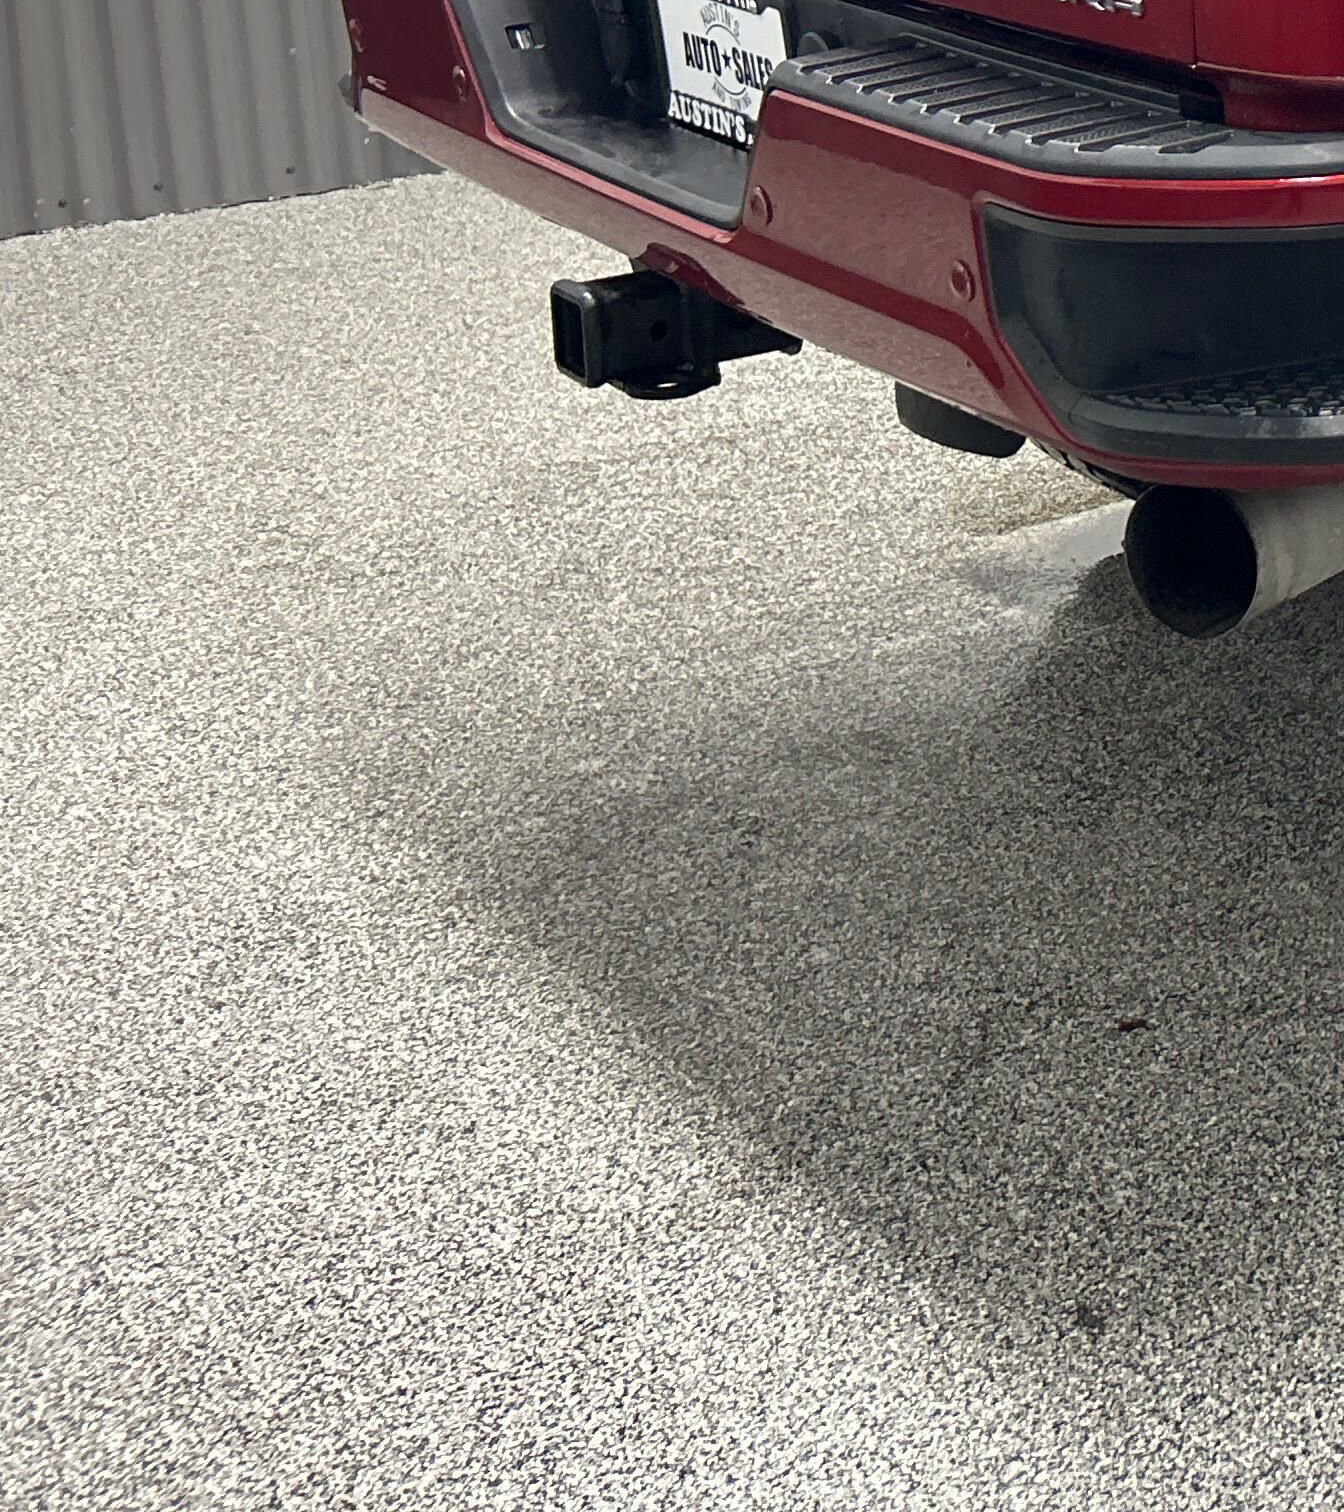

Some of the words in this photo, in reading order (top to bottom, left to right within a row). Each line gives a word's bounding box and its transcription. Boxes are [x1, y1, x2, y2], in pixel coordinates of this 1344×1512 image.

[683, 31, 722, 76] AUTO
[732, 47, 773, 89] SALES
[668, 92, 746, 143] AUSTIN'S
